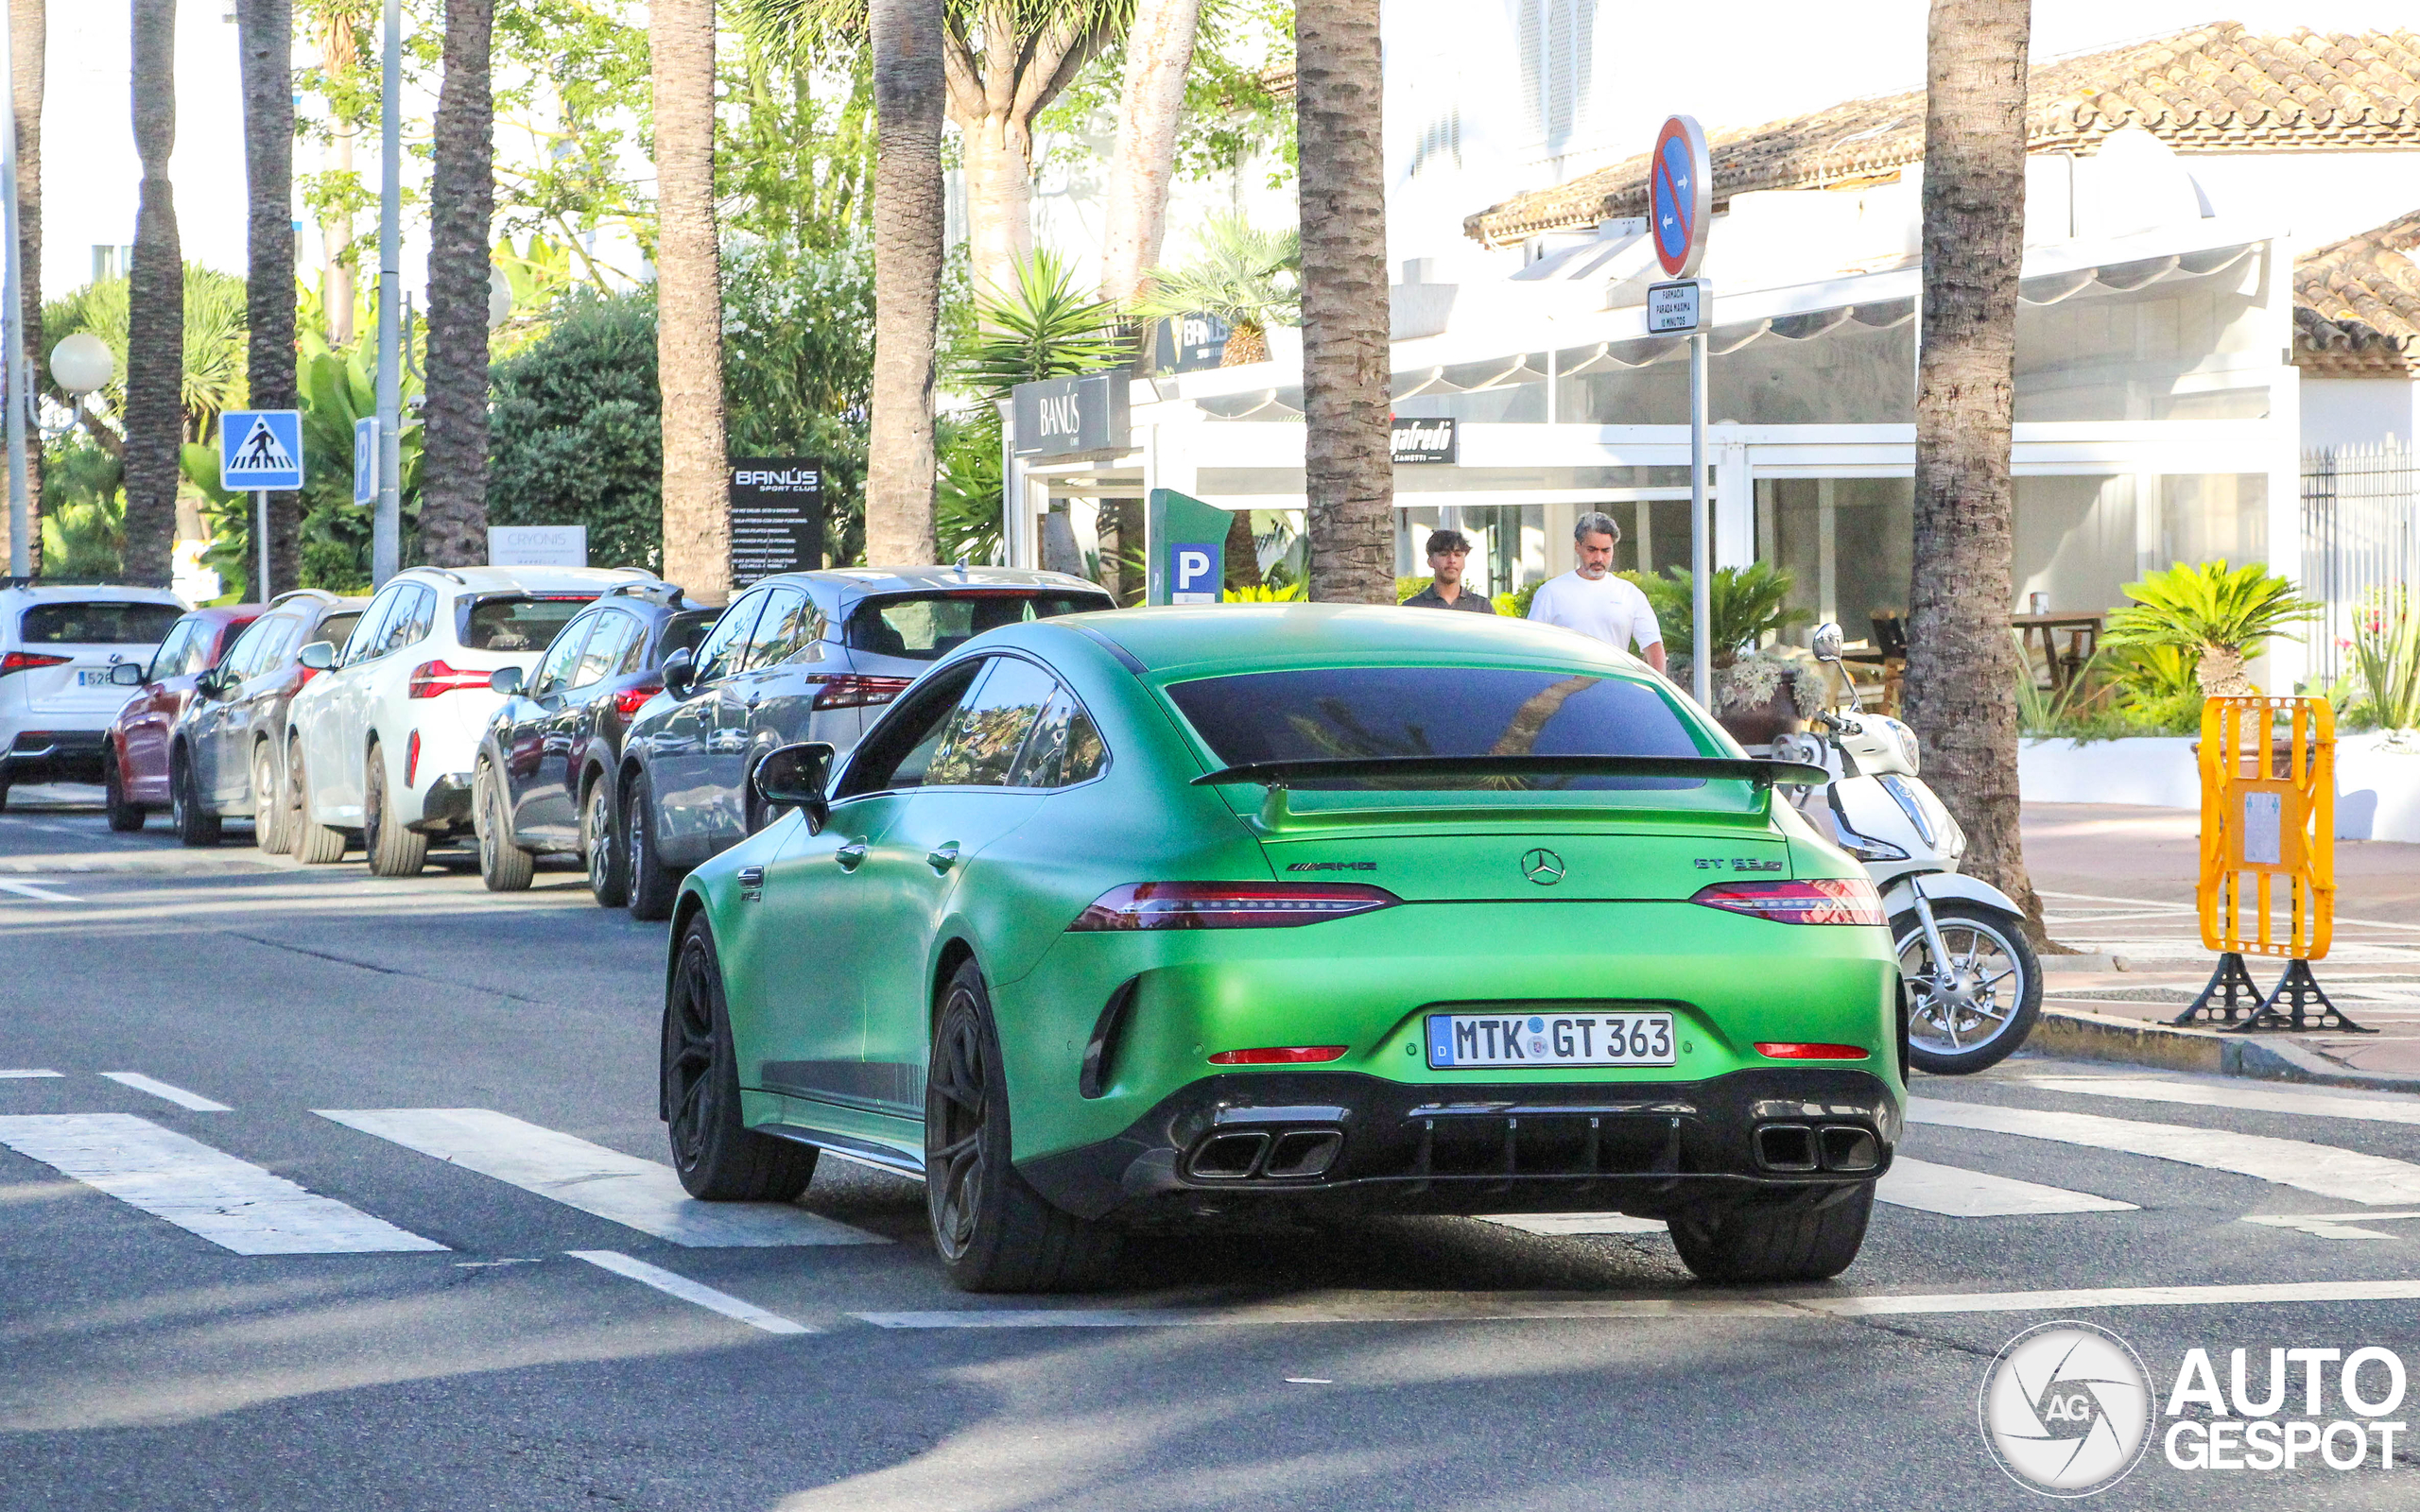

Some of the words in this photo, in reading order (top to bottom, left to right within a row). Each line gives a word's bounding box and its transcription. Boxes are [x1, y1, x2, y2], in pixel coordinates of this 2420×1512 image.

[1656, 303, 1673, 315] PARADA
[1040, 382, 1080, 437] BANÚS
[358, 430, 368, 492] P
[735, 467, 818, 485] BANÚS
[508, 532, 567, 545] CRYONIS
[1179, 551, 1210, 589] P
[1694, 858, 1724, 869] GT
[1437, 1045, 1447, 1057] D
[1455, 1020, 1525, 1059] MTK
[1552, 1019, 1597, 1058] GT
[1605, 1019, 1670, 1057] 363
